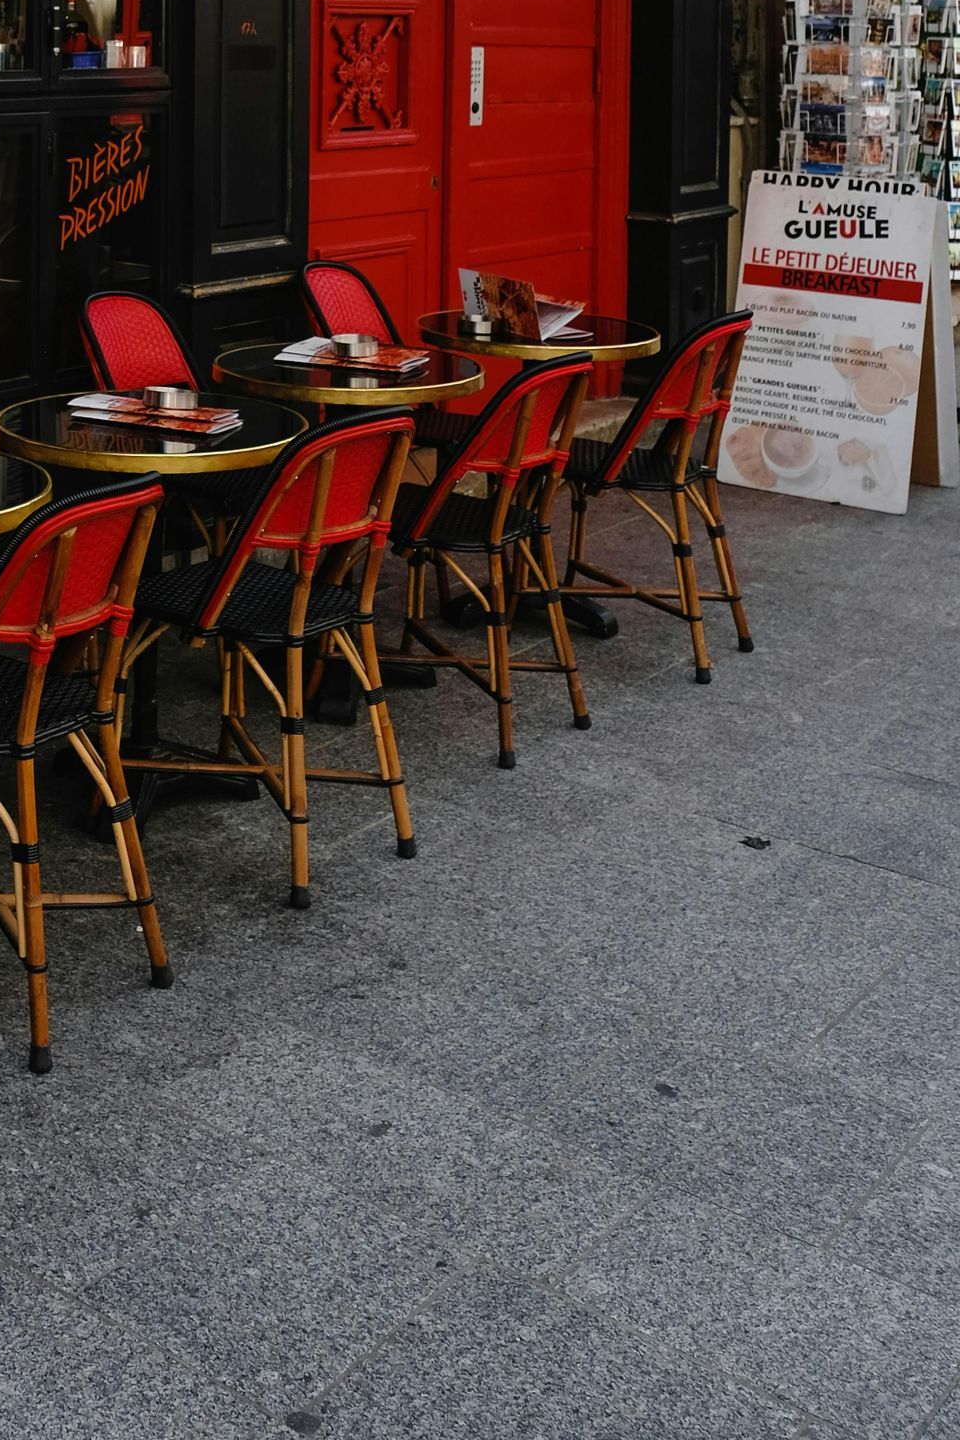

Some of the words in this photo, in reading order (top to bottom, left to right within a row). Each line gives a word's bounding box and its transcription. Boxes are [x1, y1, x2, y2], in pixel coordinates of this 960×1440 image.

[65, 124, 144, 203] BIÈRES
[58, 164, 151, 251] PRESSION
[799, 200, 877, 219] L'AMUSE
[784, 220, 889, 239] GUEULE
[752, 247, 771, 264] LE
[775, 250, 821, 270] PETIT
[825, 252, 917, 279] DÉJEUNER
[782, 269, 883, 296] BREAKFAST
[832, 314, 857, 322] NATURE
[745, 335, 768, 343] OISSON
[770, 338, 795, 346] CHAUDE
[796, 352, 820, 361] TARTINE
[823, 355, 848, 364] BEURRE
[736, 386, 762, 394] BRIOCHE
[733, 407, 759, 415] ORANGE
[734, 397, 761, 405] BOISSON
[764, 400, 789, 410] CHAUDE
[761, 421, 776, 429] PLAT
[778, 424, 803, 433] NATURE
[816, 430, 839, 439] BACON
